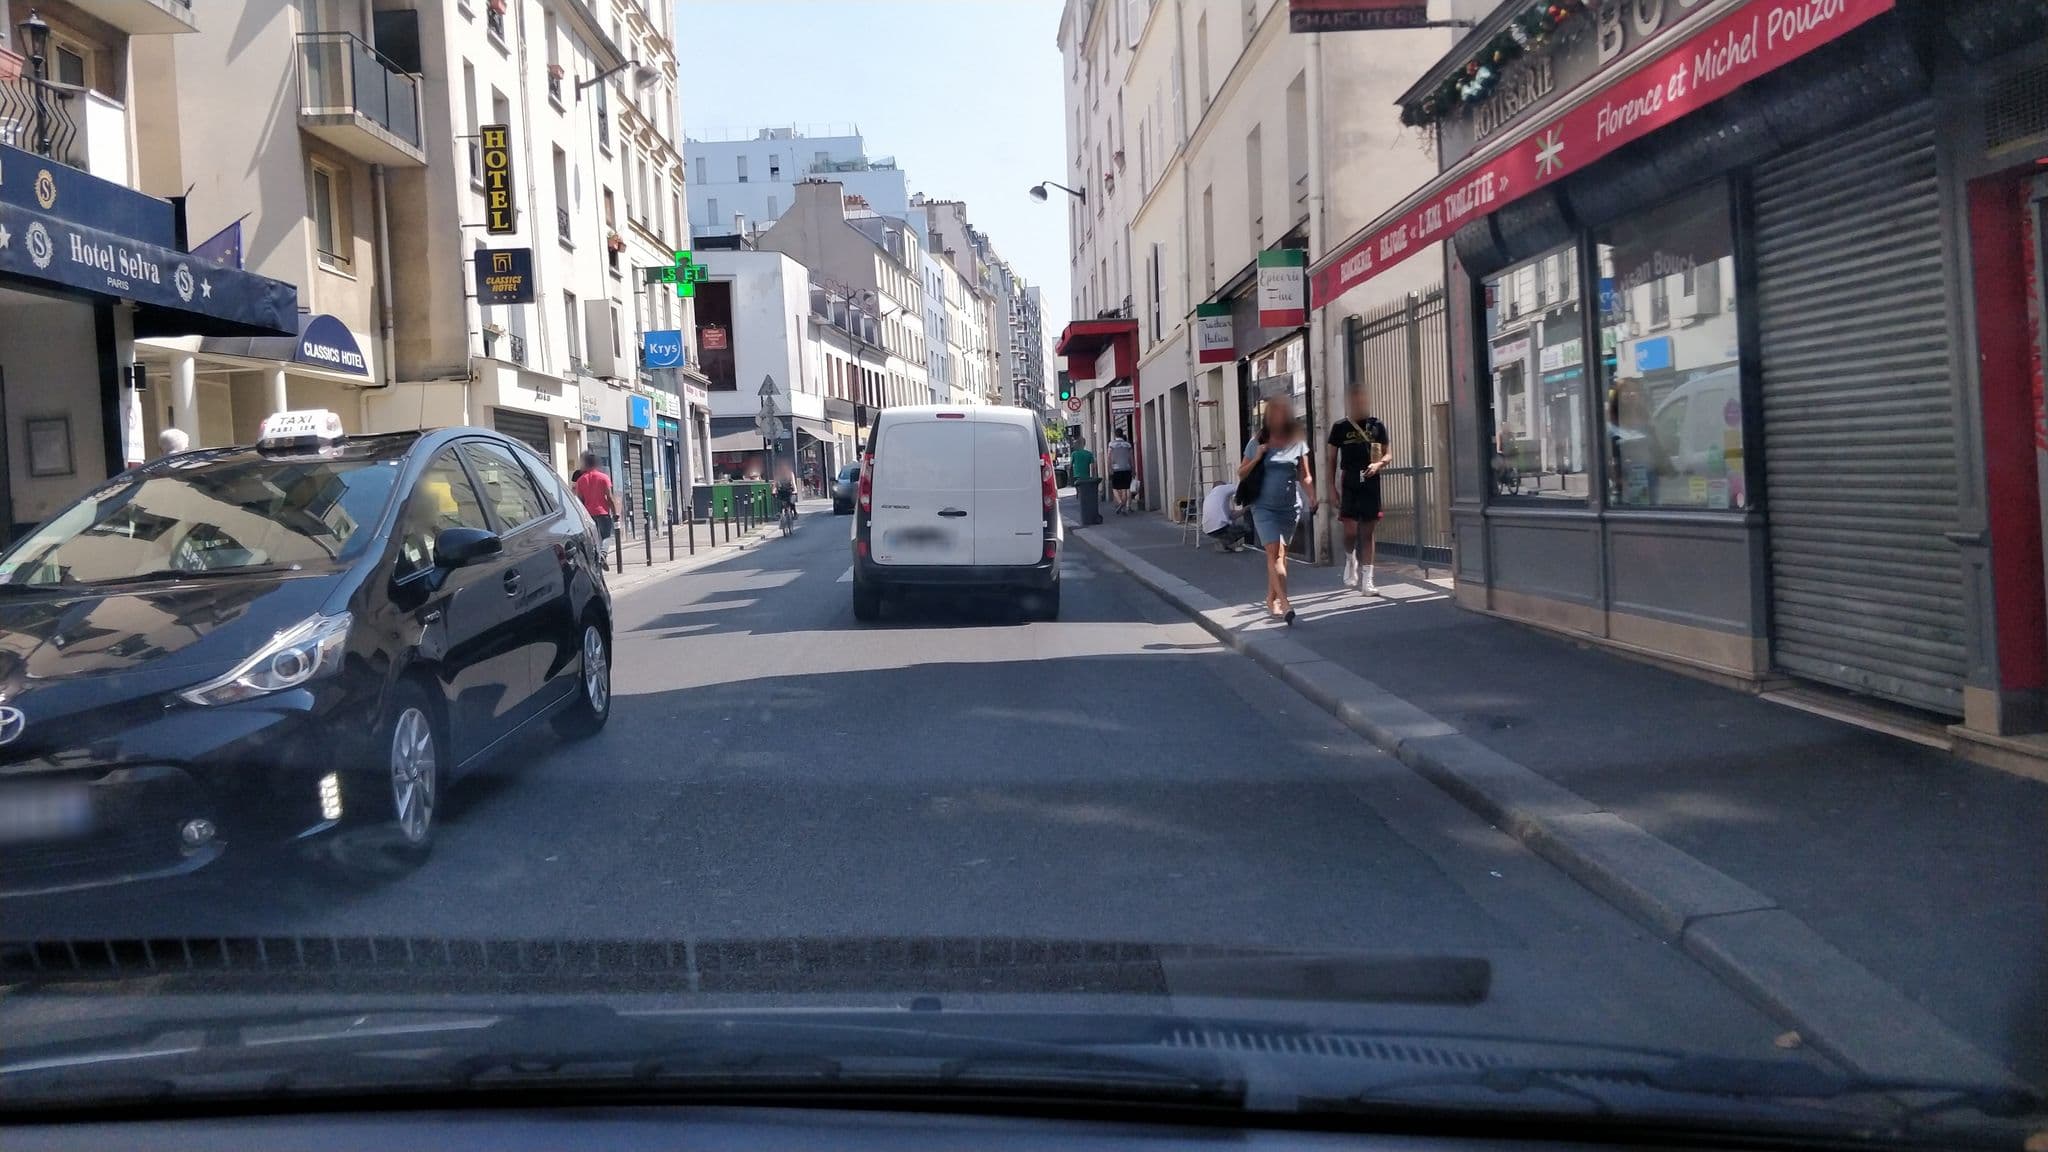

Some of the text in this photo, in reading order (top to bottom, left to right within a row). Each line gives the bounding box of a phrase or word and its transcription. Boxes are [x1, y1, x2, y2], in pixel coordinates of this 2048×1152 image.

[1597, 83, 1662, 142] Florence
[1667, 61, 1688, 103] et
[1693, 16, 1758, 90] Michel
[484, 131, 509, 229] HOTEL
[69, 232, 116, 273] Hotel
[119, 247, 161, 285] Selva
[106, 276, 130, 291] PARIS
[485, 275, 522, 285] CLASSICS
[492, 284, 518, 292] HOTEL
[304, 342, 364, 368] CLASSICS HOTEL
[650, 343, 678, 356] Krys
[280, 415, 313, 425] TAXI
